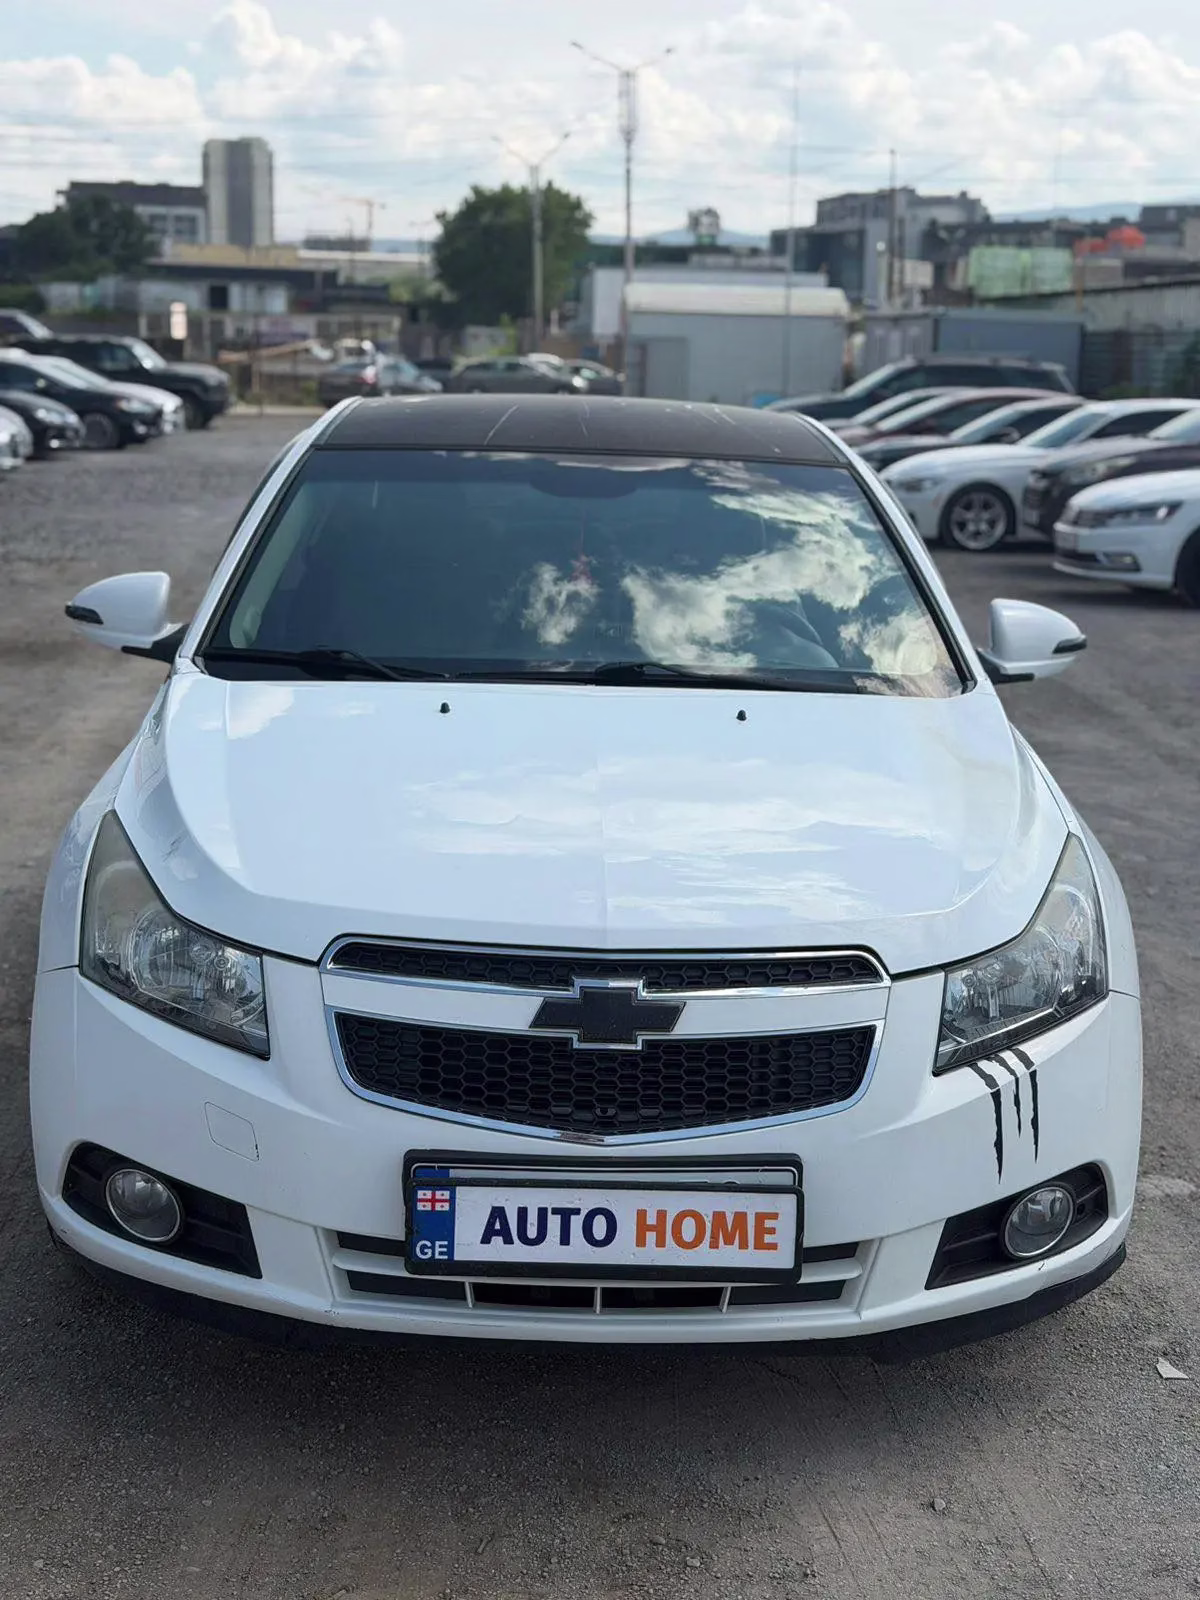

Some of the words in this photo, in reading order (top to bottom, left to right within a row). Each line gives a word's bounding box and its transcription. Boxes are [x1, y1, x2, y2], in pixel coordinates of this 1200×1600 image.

[479, 1206, 618, 1248] AUTO
[635, 1209, 780, 1250] HOME
[415, 1239, 449, 1260] GE
